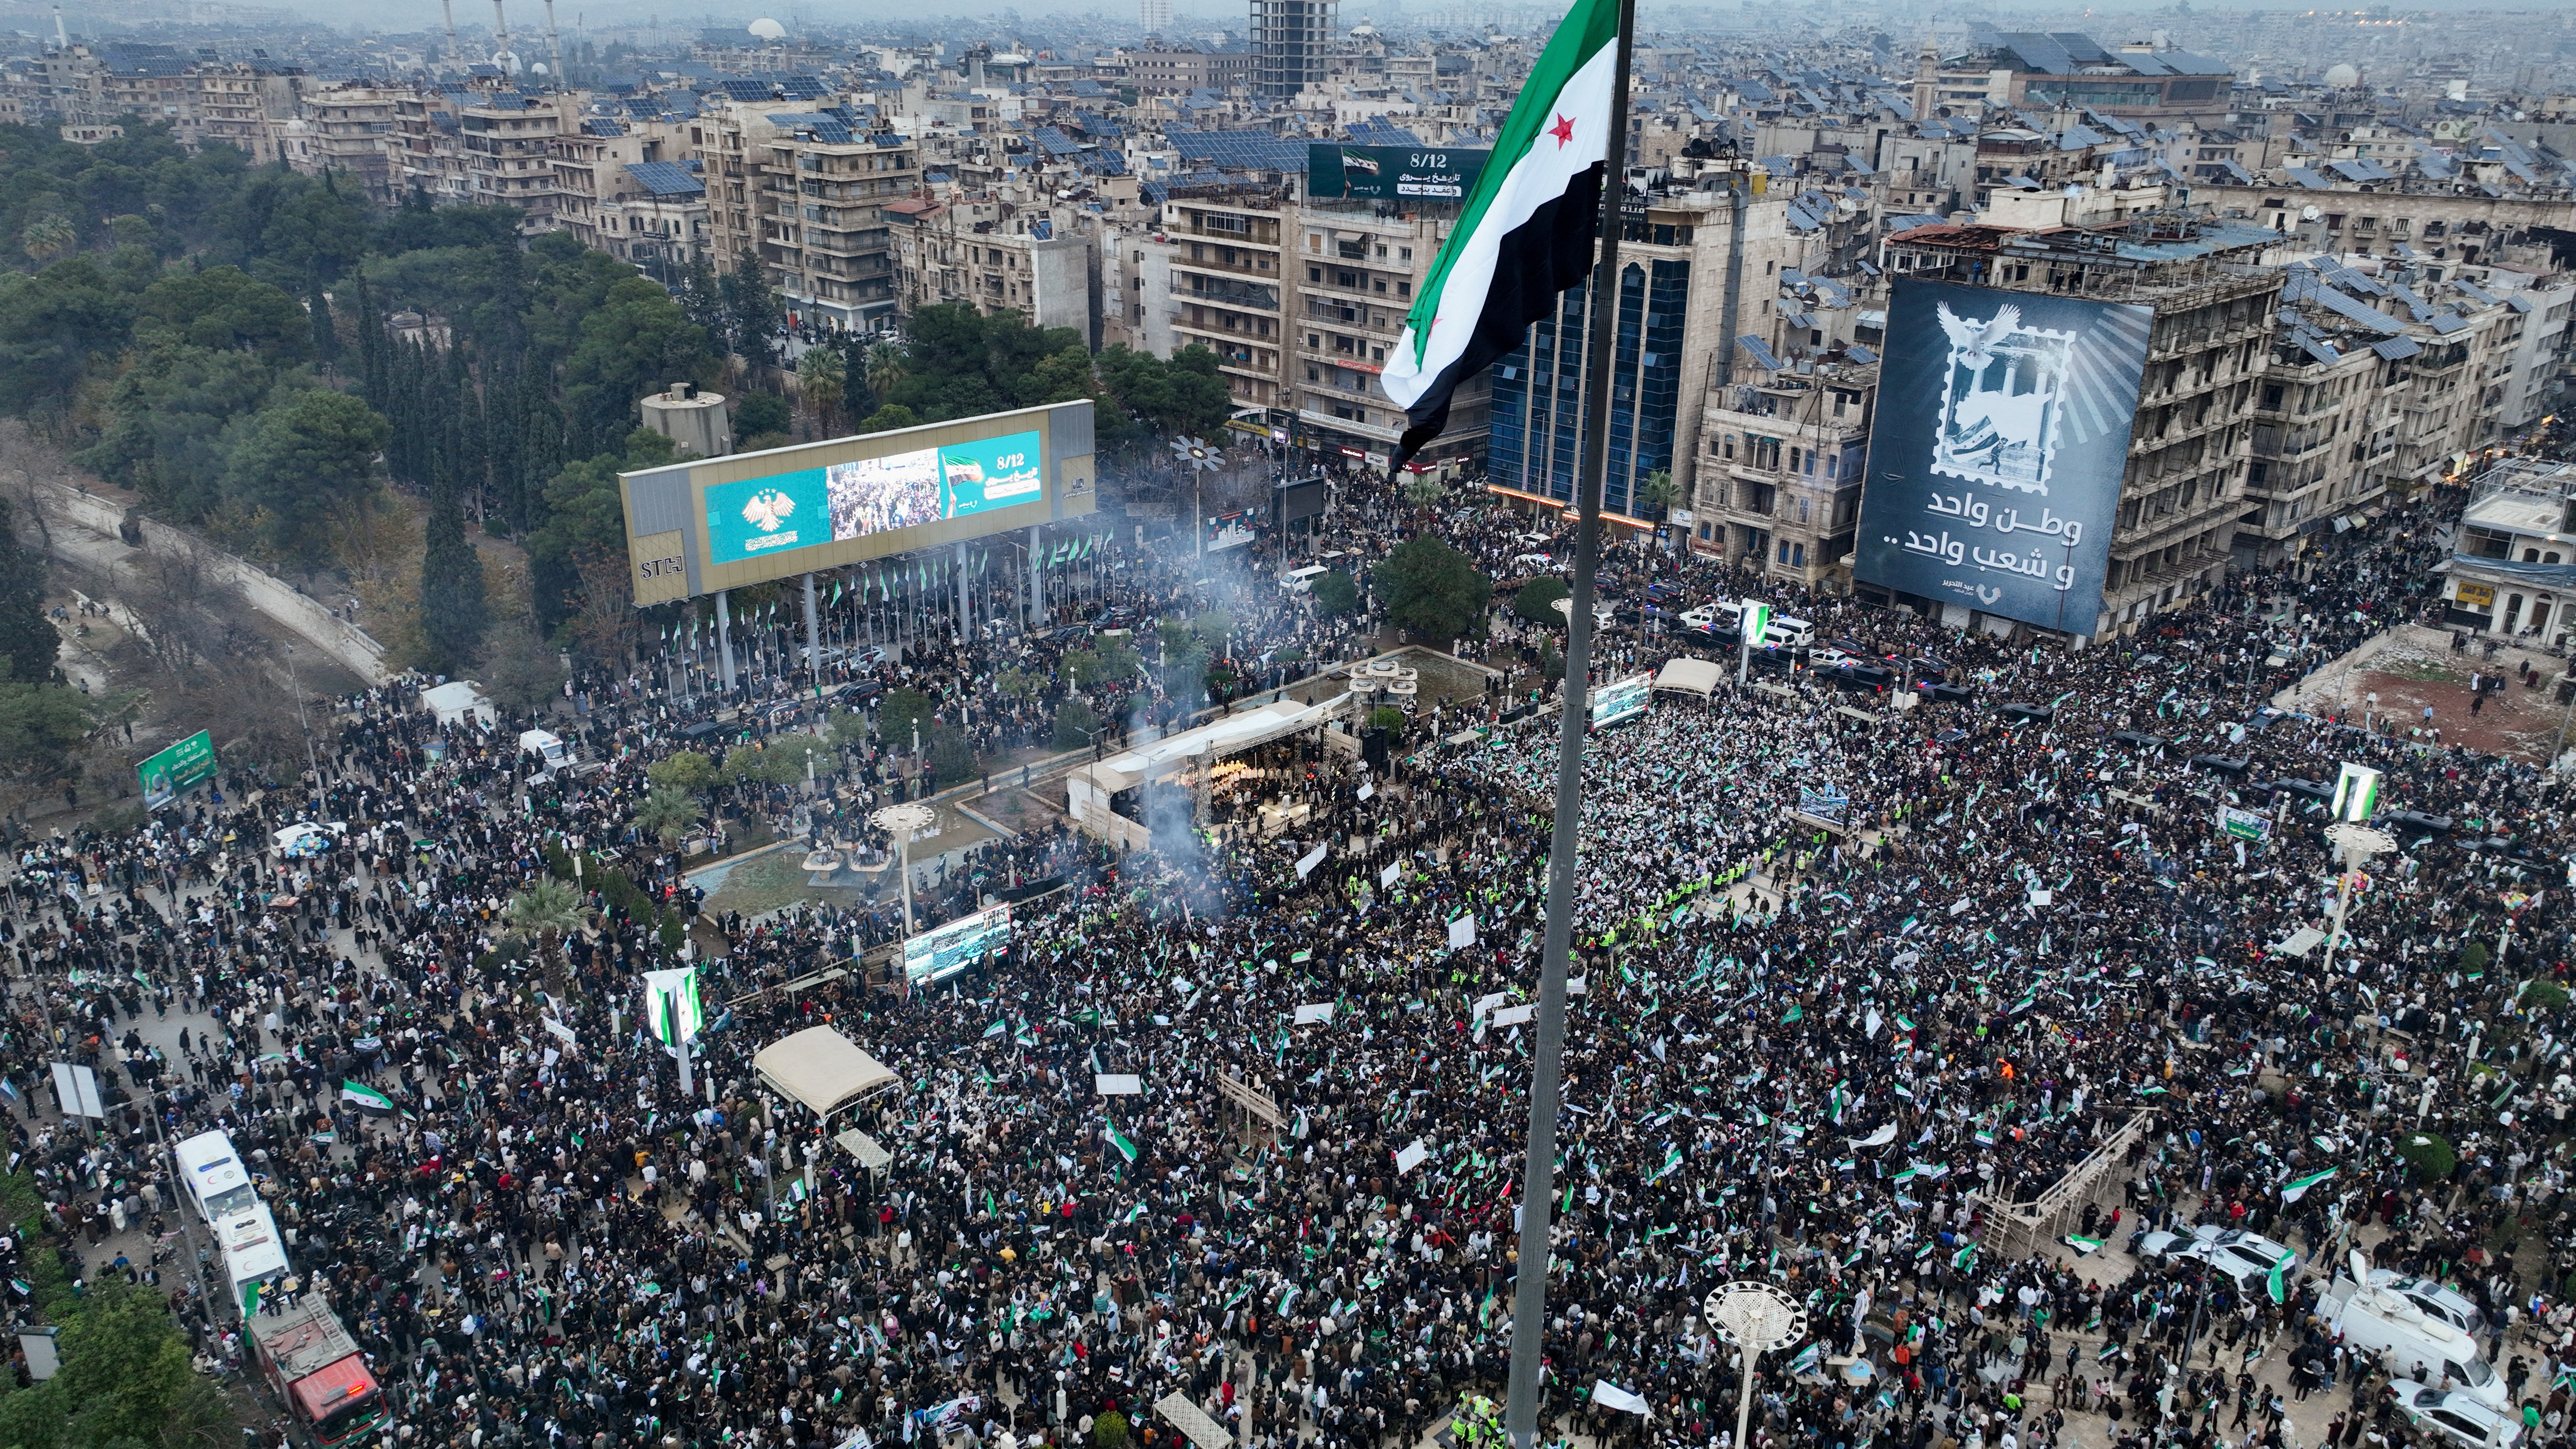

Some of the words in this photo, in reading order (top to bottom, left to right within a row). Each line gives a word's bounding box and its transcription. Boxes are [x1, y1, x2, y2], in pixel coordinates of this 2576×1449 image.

[1410, 153, 1447, 168] 8/12
[1323, 415, 1338, 423] FARZAT
[1363, 425, 1393, 436] DEVELOPMENT
[997, 453, 1024, 470] 8/12
[1928, 492, 1990, 527] واحد
[1995, 507, 2083, 546] وطن
[1905, 530, 1965, 565] واحد
[1972, 547, 2047, 578] شعب
[1942, 579, 1962, 589] التحرير
[1963, 583, 1974, 591] عيد
